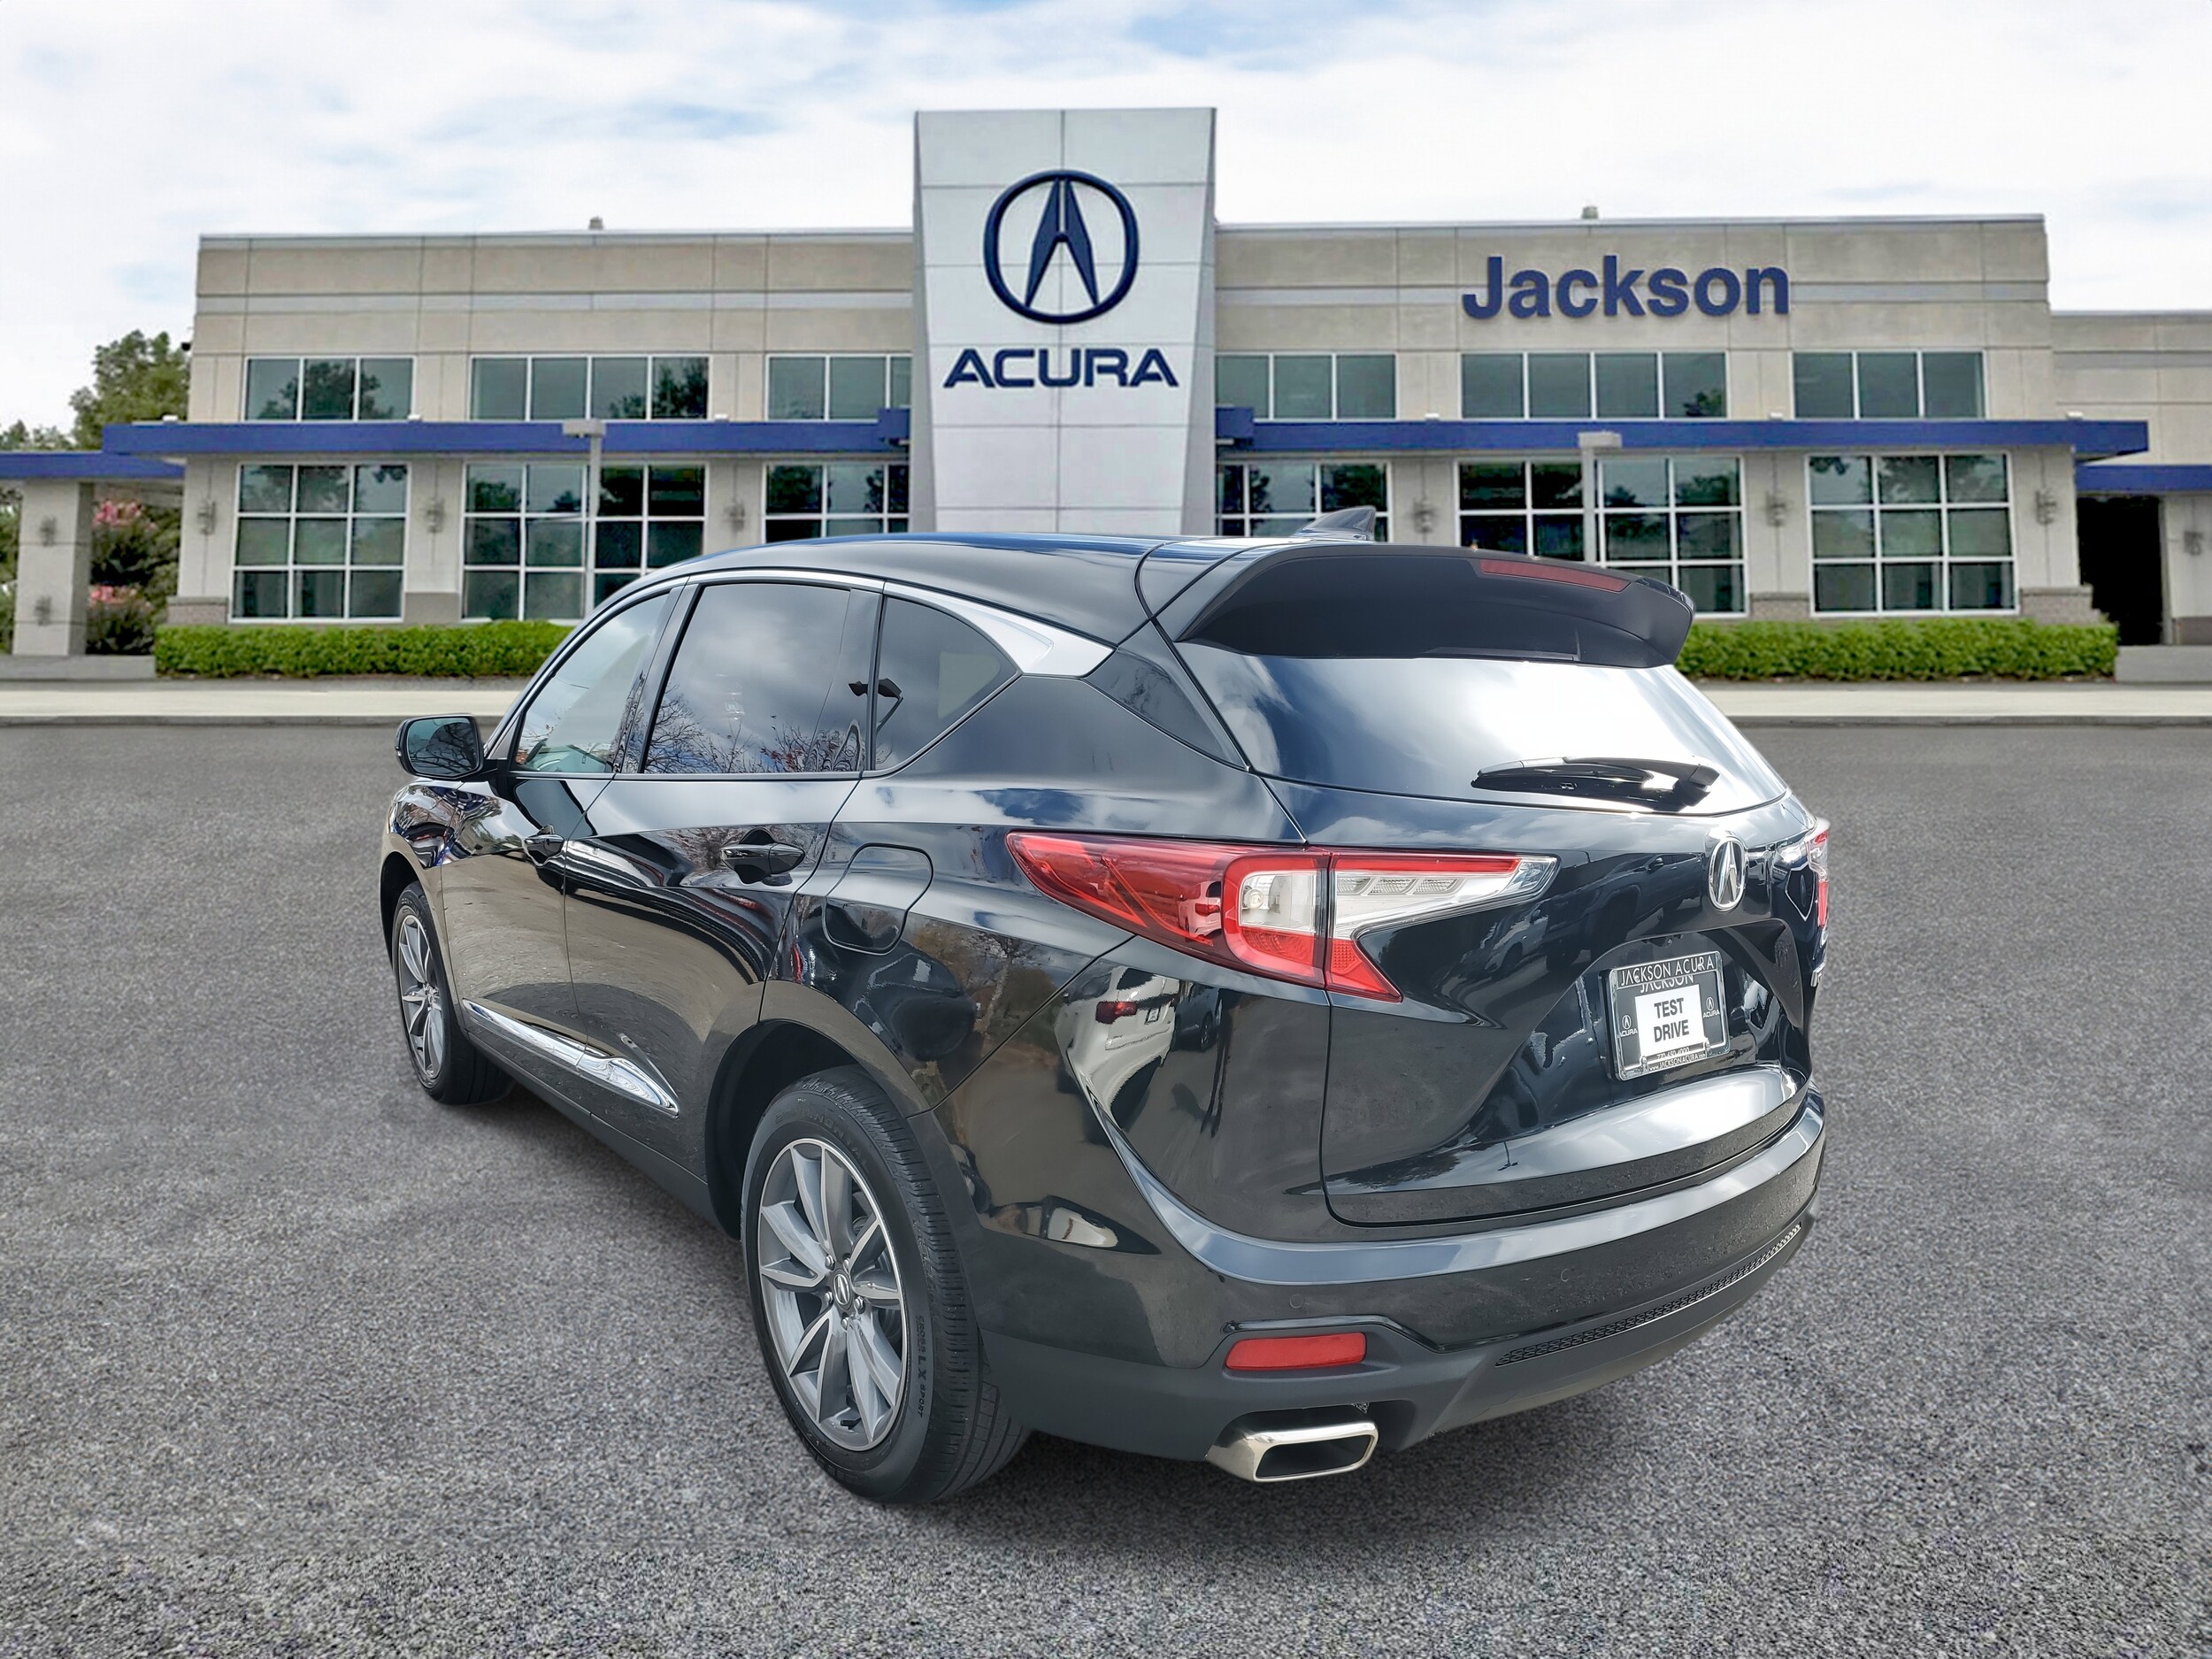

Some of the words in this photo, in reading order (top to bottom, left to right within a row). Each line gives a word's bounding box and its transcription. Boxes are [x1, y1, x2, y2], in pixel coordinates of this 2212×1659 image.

[1463, 255, 1789, 319] Jackson
[943, 349, 1179, 388] ACURA
[1621, 963, 1671, 986] JACKSON
[1675, 956, 1715, 976] ACURA
[1654, 997, 1684, 1018] TEST
[1703, 1009, 1720, 1018] ACURA
[1654, 1019, 1689, 1042] DRIVE
